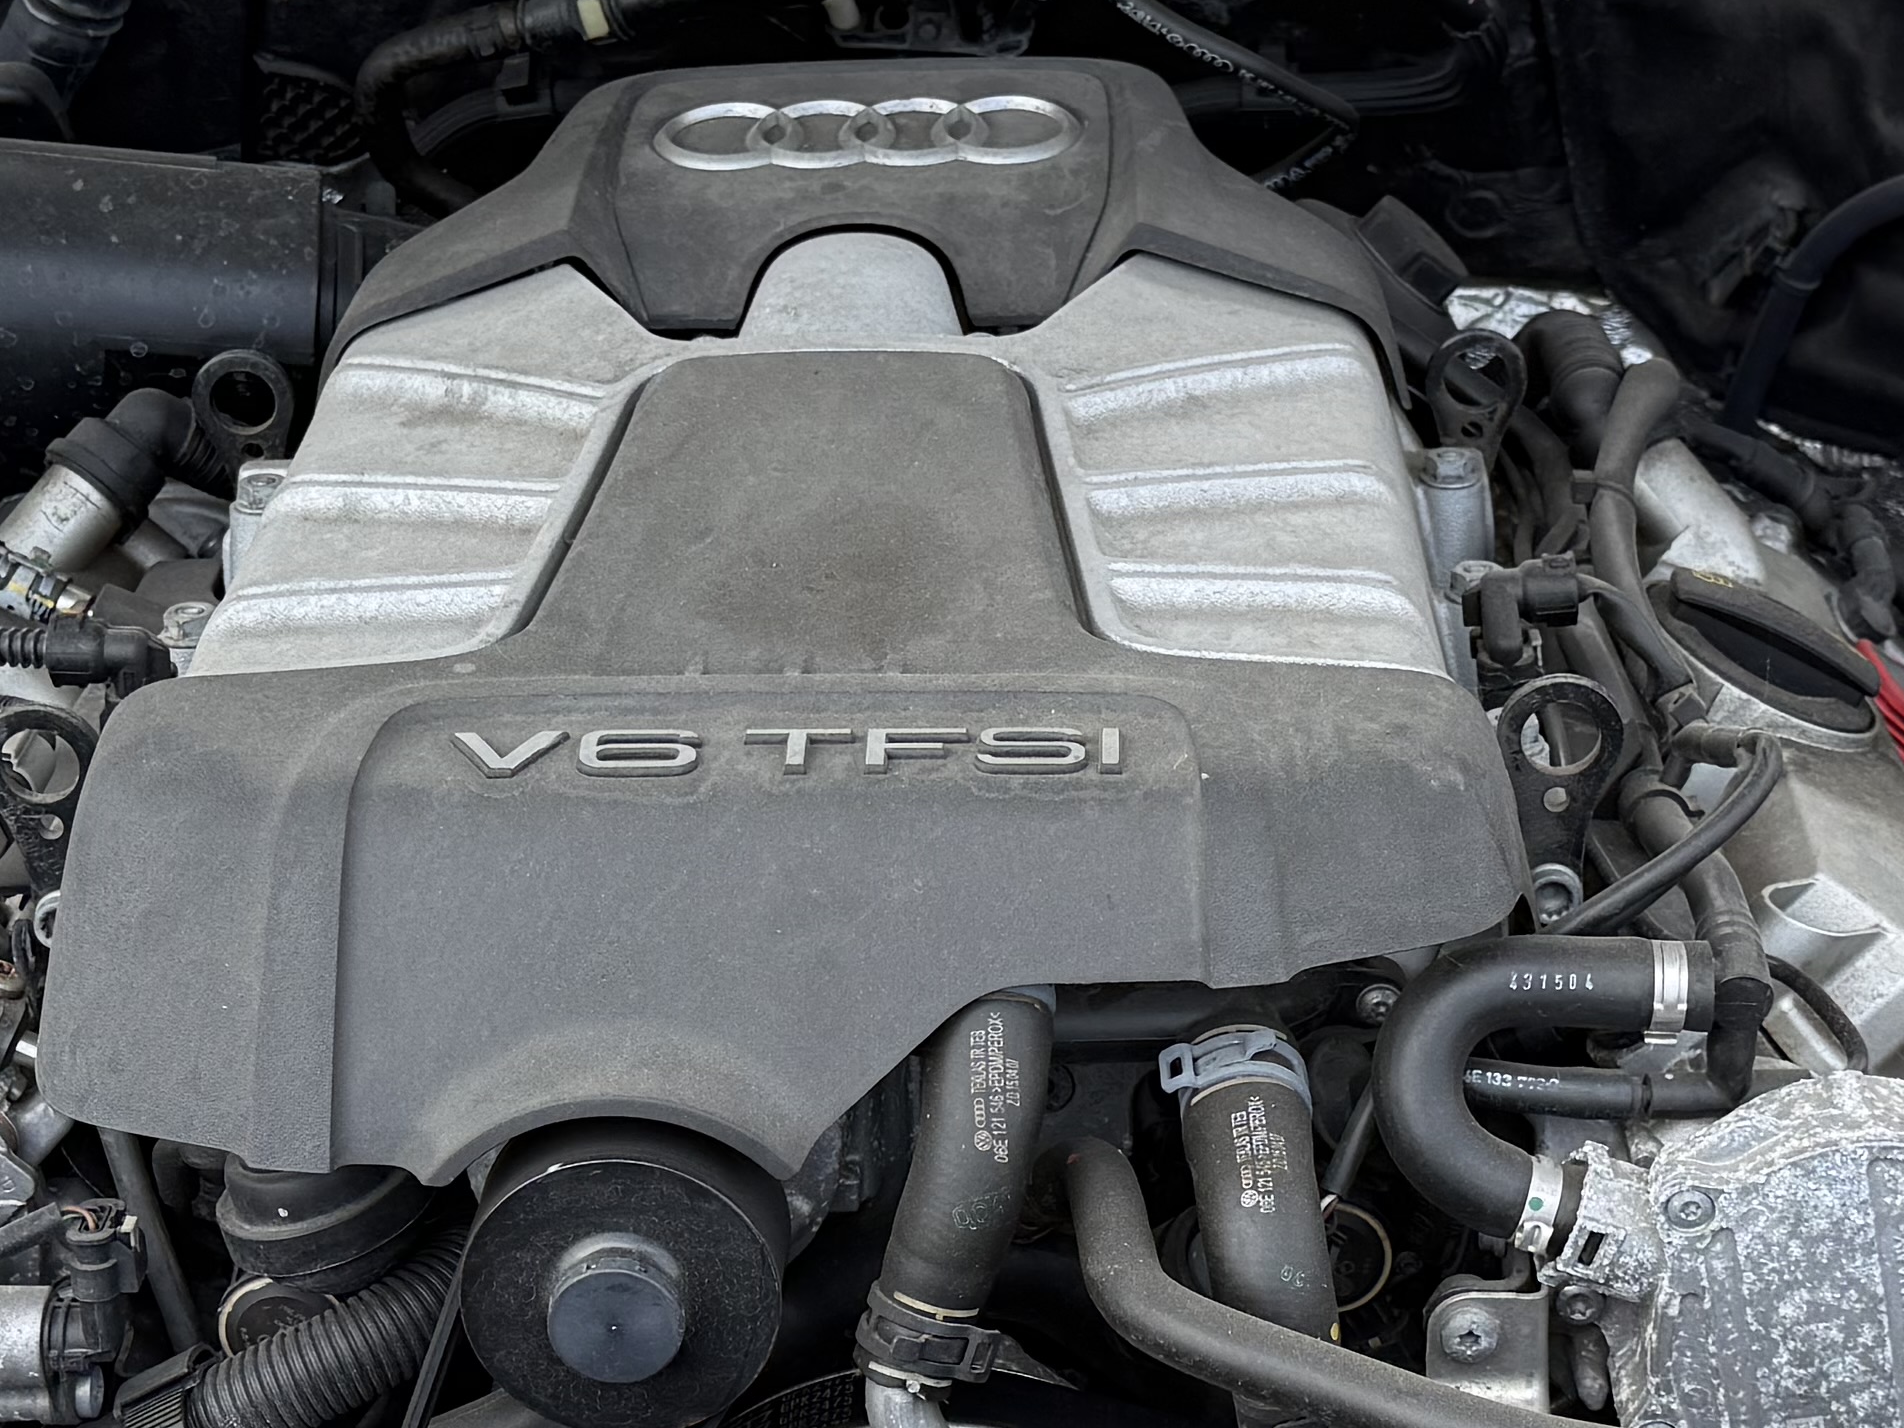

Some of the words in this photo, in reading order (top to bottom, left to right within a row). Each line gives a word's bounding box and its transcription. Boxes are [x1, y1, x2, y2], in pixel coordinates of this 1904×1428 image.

[452, 728, 703, 778] V6
[744, 726, 1123, 775] TFSI
[1509, 972, 1594, 990] 431504
